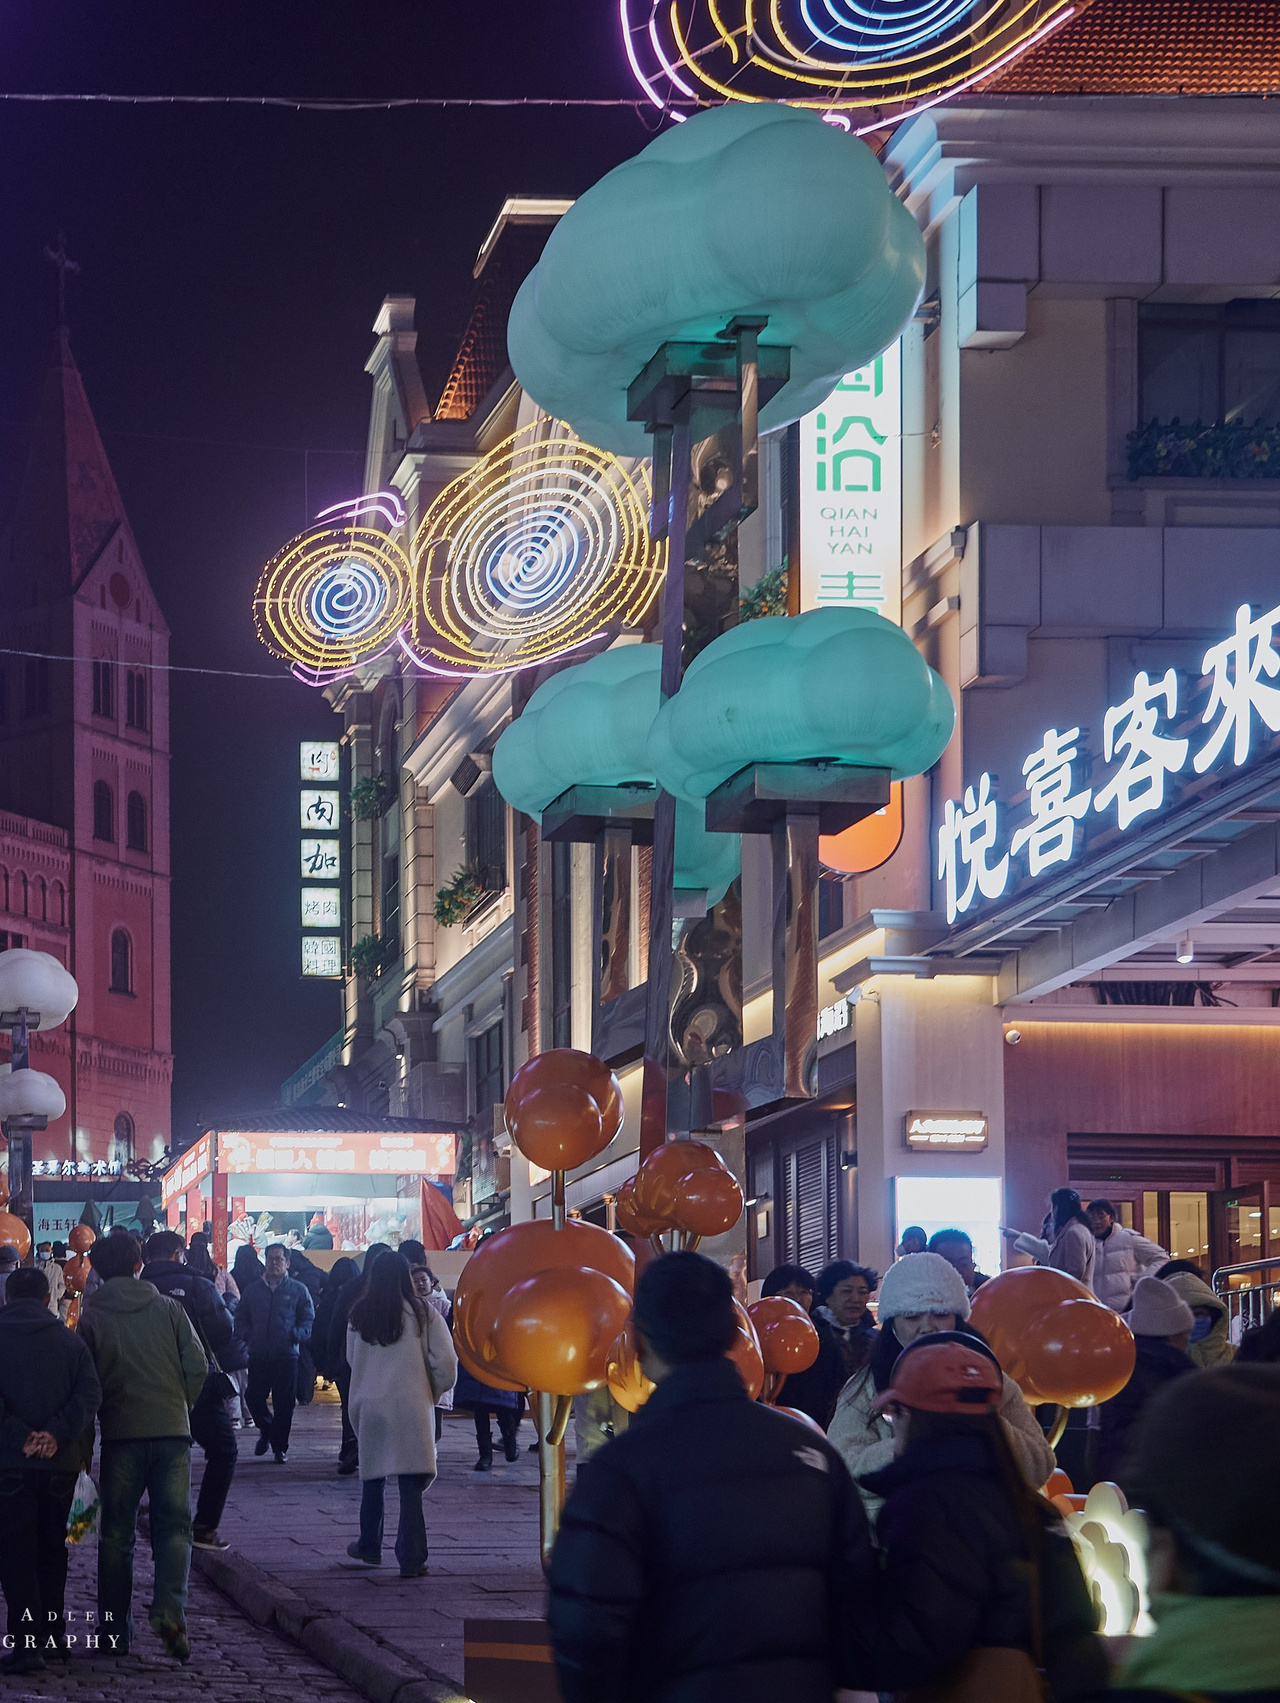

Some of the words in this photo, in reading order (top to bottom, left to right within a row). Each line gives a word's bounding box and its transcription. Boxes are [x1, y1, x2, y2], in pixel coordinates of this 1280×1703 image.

[820, 506, 878, 521] QIAN
[829, 525, 869, 538] HAI
[827, 542, 873, 555] YAN
[304, 900, 338, 916] 烤肉
